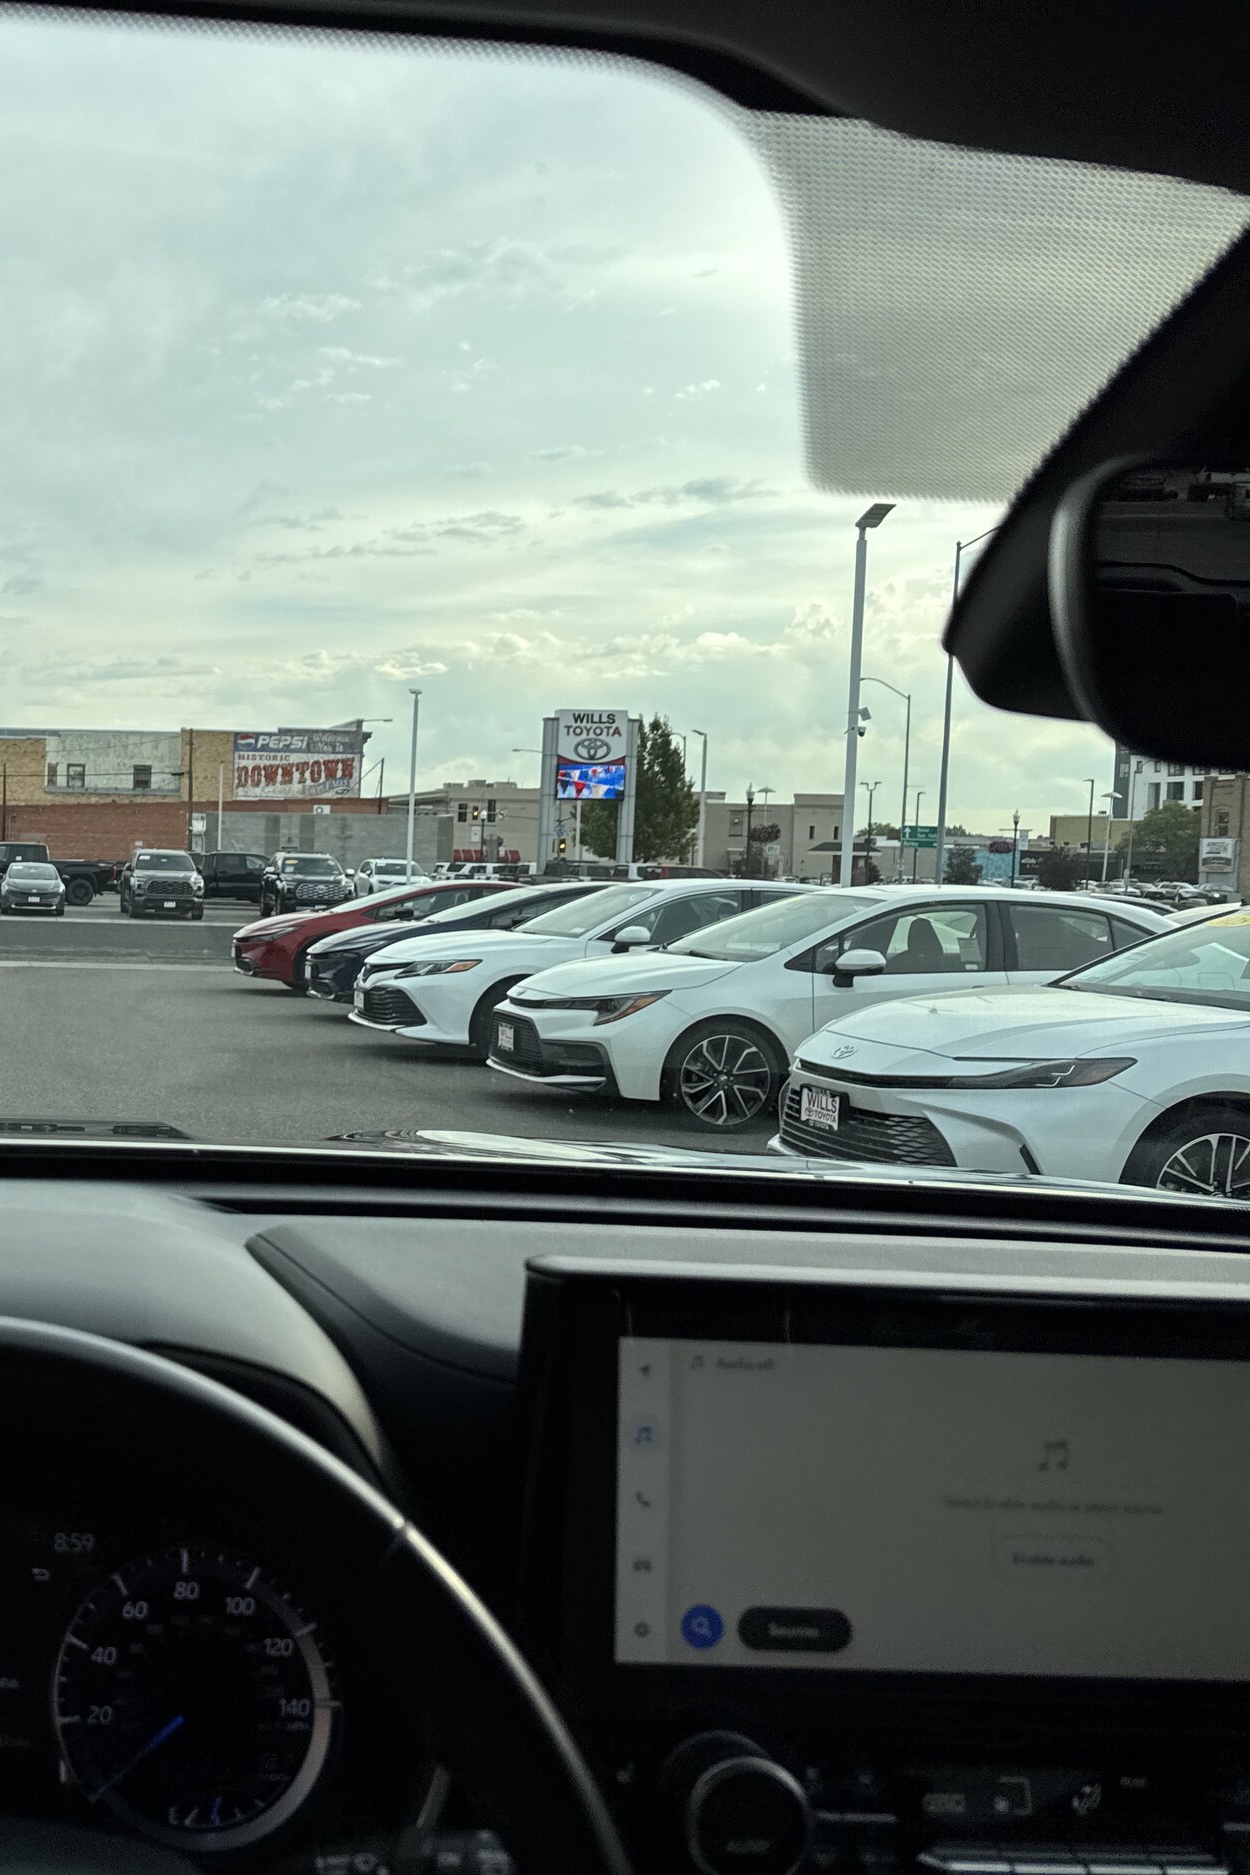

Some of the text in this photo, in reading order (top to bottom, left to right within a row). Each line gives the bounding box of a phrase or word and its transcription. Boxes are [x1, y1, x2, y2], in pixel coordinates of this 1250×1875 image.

[573, 713, 616, 724] WILLS
[564, 725, 622, 737] TOYOTA
[257, 735, 308, 749] PEPSI
[238, 754, 290, 762] HISTORIC
[236, 757, 355, 788] DOWNTOWN
[807, 1092, 837, 1114] WILLS
[815, 1110, 837, 1124] TOYOTA
[54, 1532, 96, 1553] 8:59
[173, 1581, 200, 1600] 80
[122, 1601, 148, 1620] 60
[225, 1596, 256, 1616] 100
[90, 1647, 117, 1666] 40
[263, 1637, 295, 1658] 120
[86, 1706, 113, 1725] 20
[279, 1698, 311, 1718] 140
